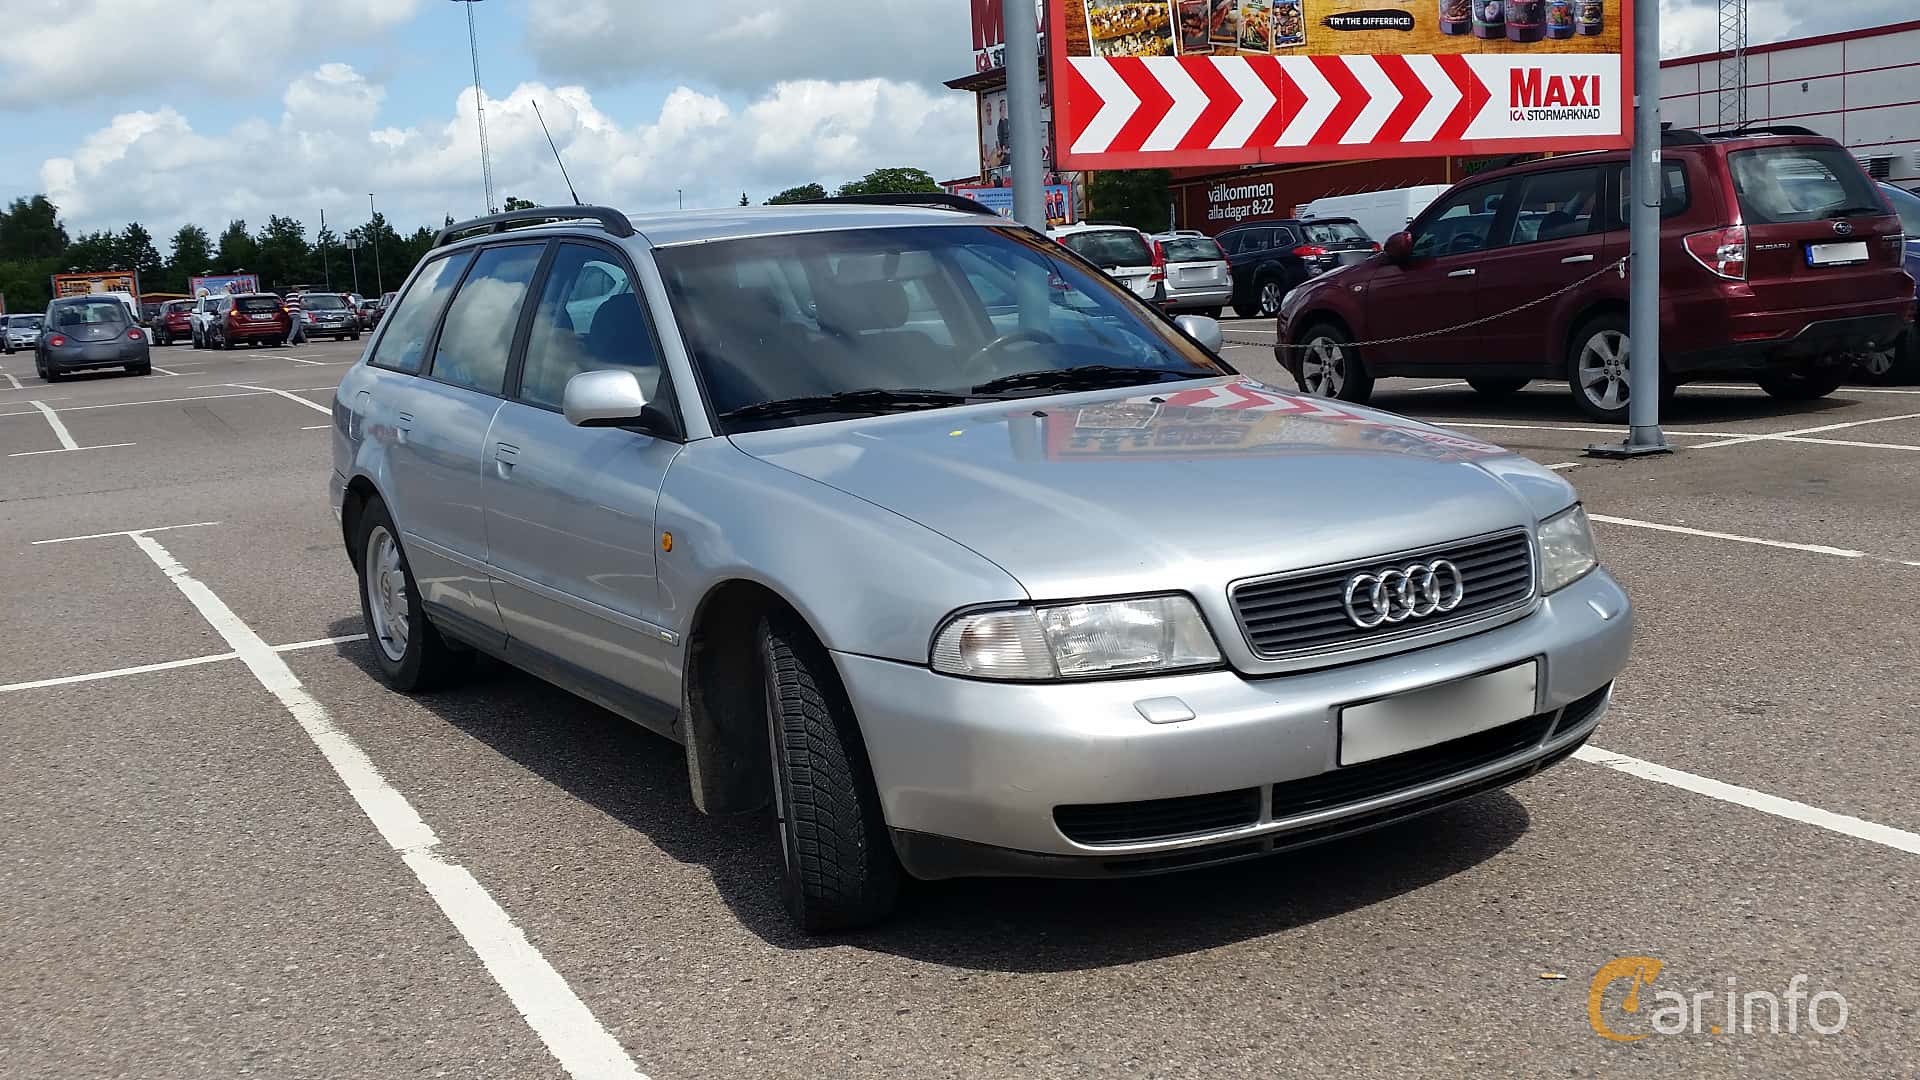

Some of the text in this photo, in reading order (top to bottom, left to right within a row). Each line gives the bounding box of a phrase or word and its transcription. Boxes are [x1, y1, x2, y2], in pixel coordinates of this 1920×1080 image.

[1329, 17, 1411, 25] TRY THE DIFFERENCE!
[1510, 68, 1600, 107] MAXI
[1510, 108, 1600, 121] ICA STORMARKNAD
[1208, 183, 1273, 203] välkommen
[1208, 198, 1274, 221] alla dagar 8-22
